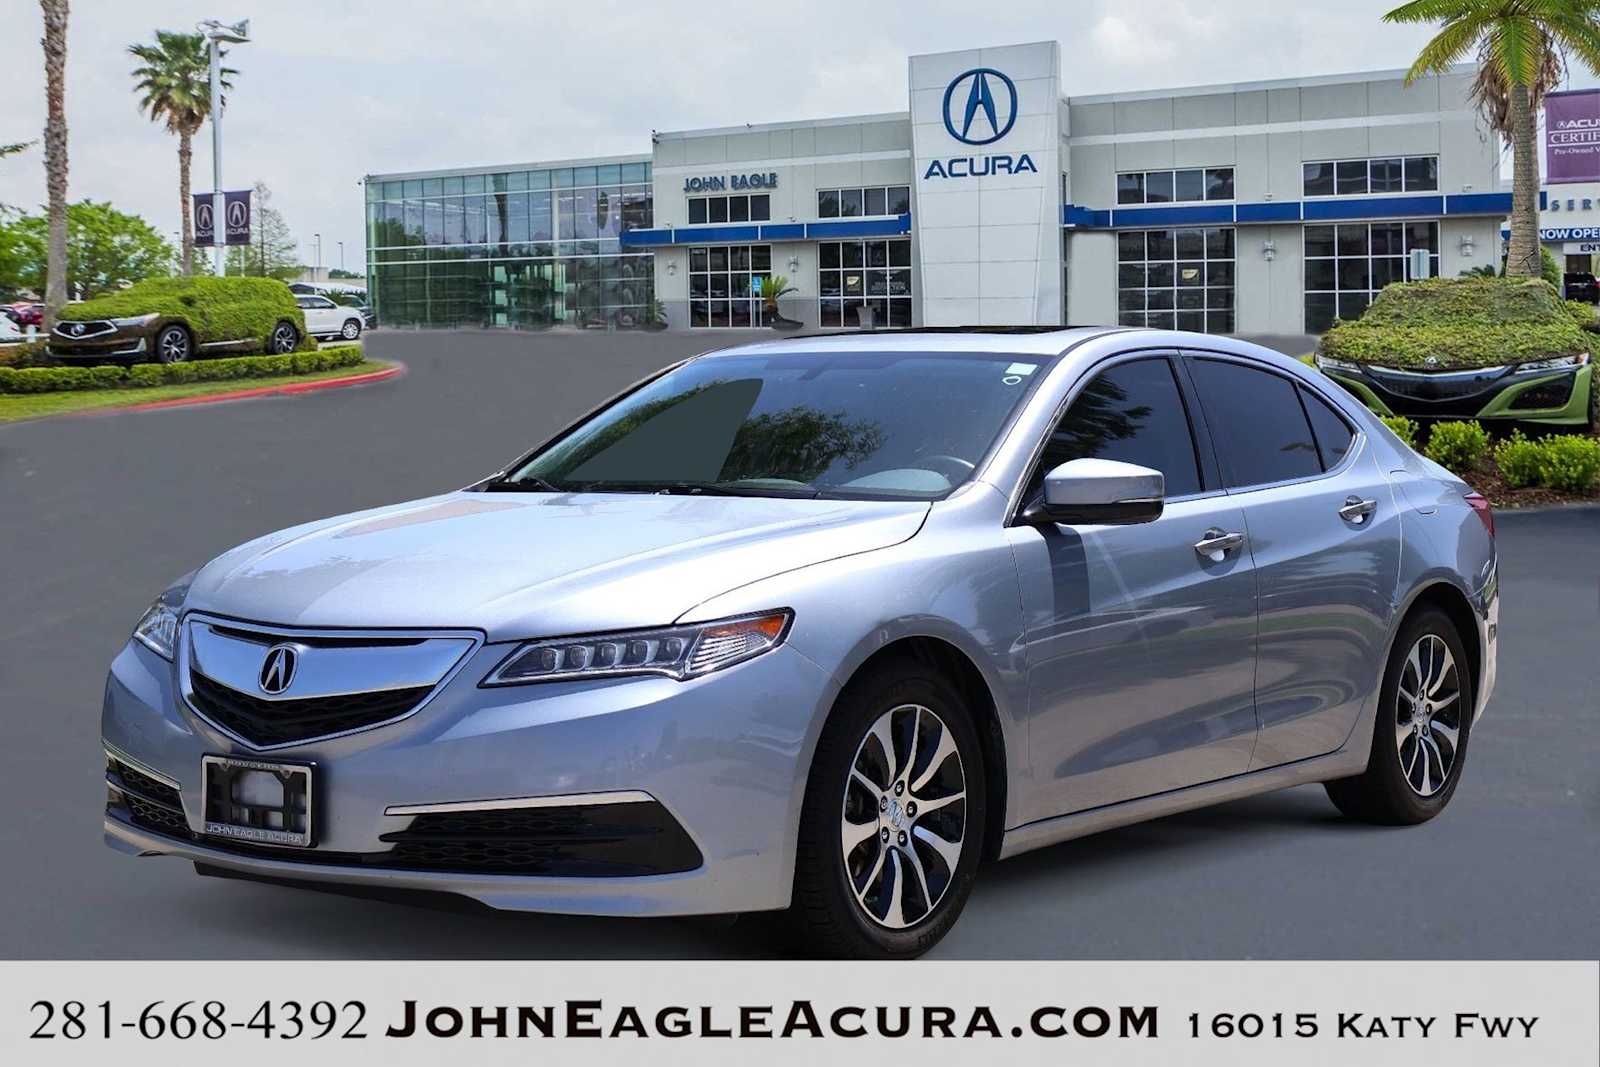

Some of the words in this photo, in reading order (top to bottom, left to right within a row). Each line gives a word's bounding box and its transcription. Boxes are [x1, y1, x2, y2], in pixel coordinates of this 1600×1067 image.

[1567, 119, 1600, 128] ACU
[924, 154, 1037, 180] ACURA
[683, 175, 726, 193] JOHN
[730, 172, 778, 191] EAGLE
[1551, 199, 1600, 211] SER
[1572, 228, 1600, 239] OPE
[207, 822, 233, 836] JOHN
[234, 827, 266, 841] EAGLE
[267, 831, 305, 844] ACURA
